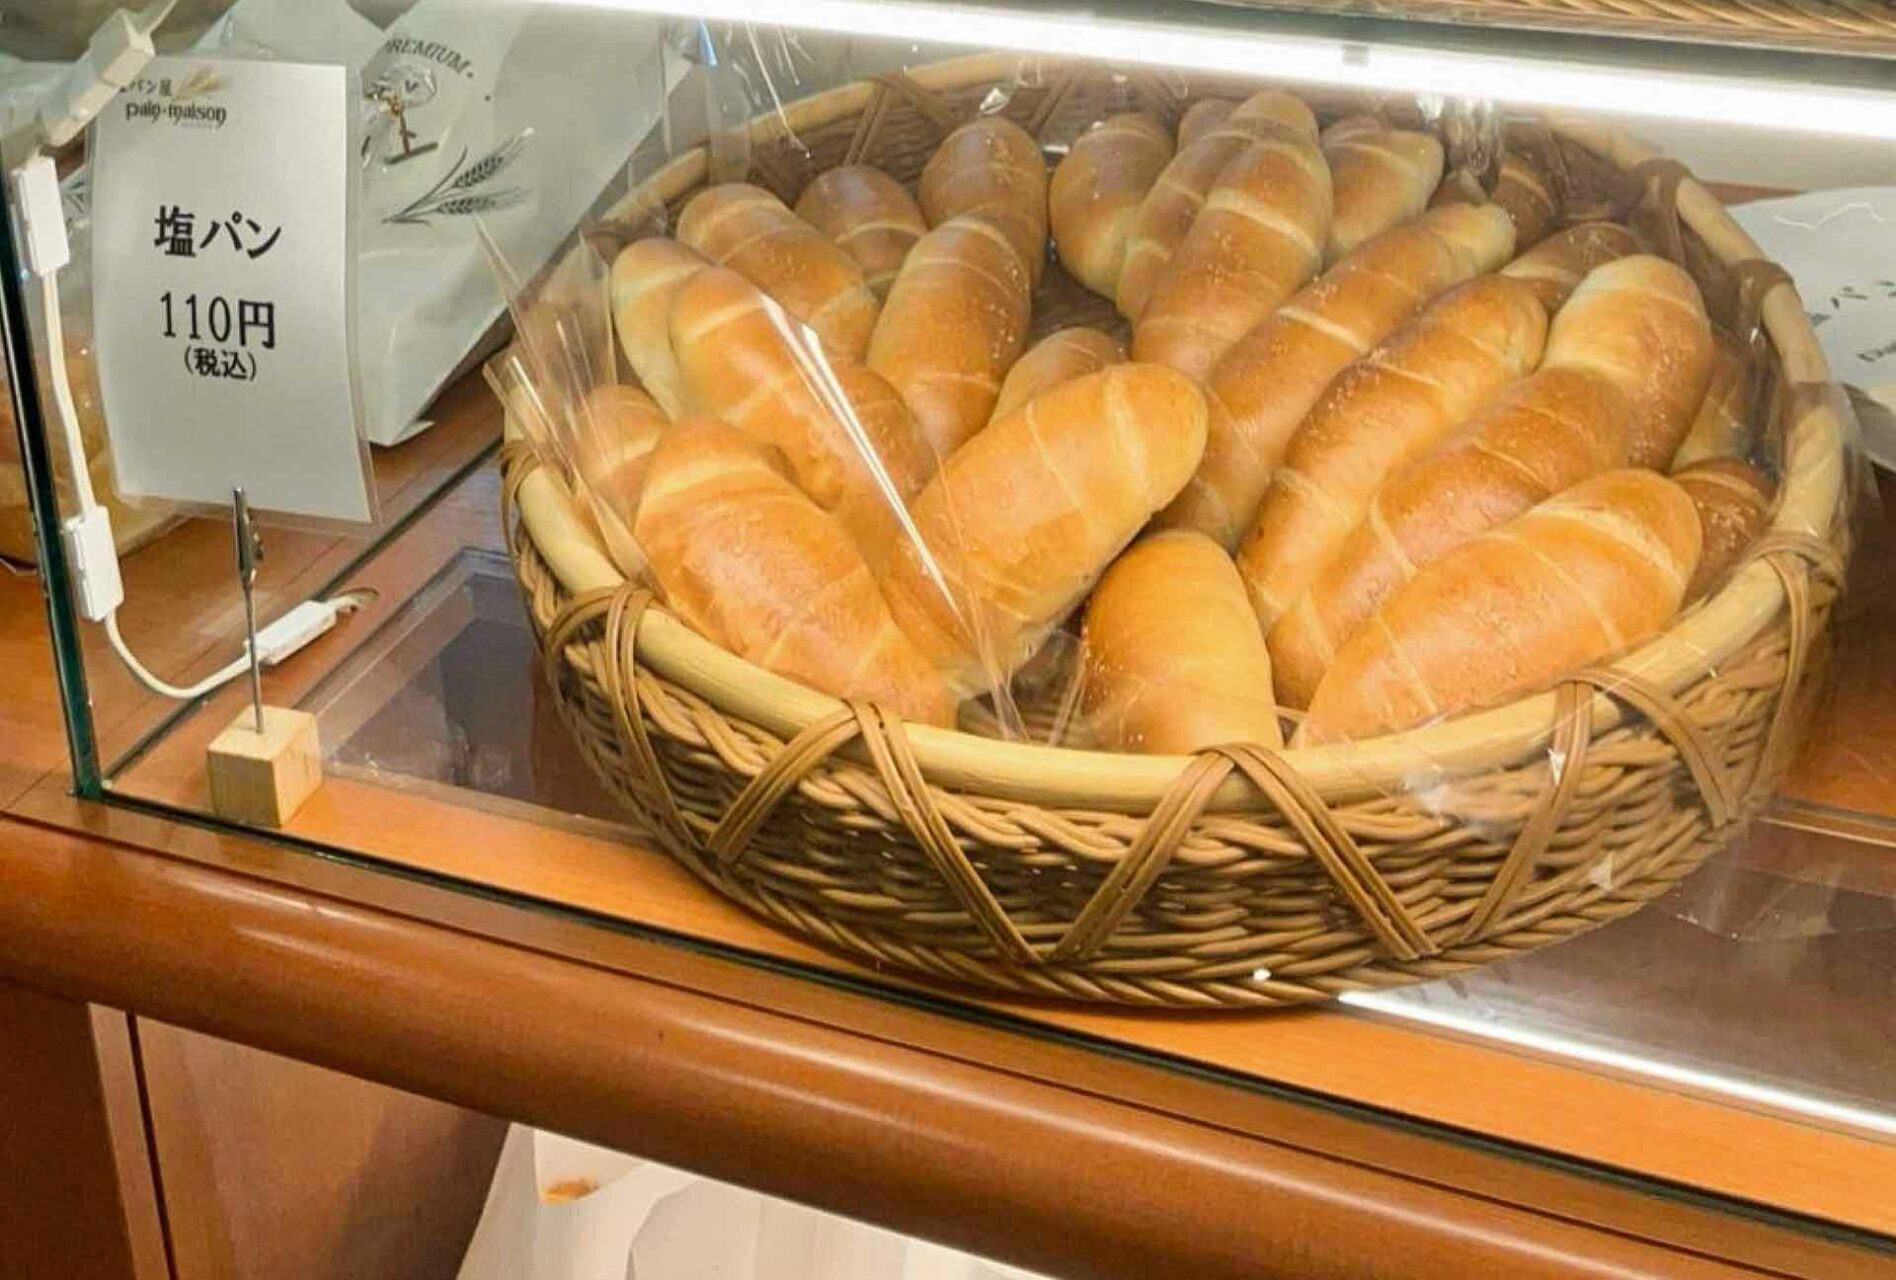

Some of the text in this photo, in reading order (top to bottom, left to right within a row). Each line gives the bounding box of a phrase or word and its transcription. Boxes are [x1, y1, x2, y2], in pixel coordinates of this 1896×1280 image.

[154, 205, 282, 260] 塩パン
[160, 291, 276, 350] 110円
